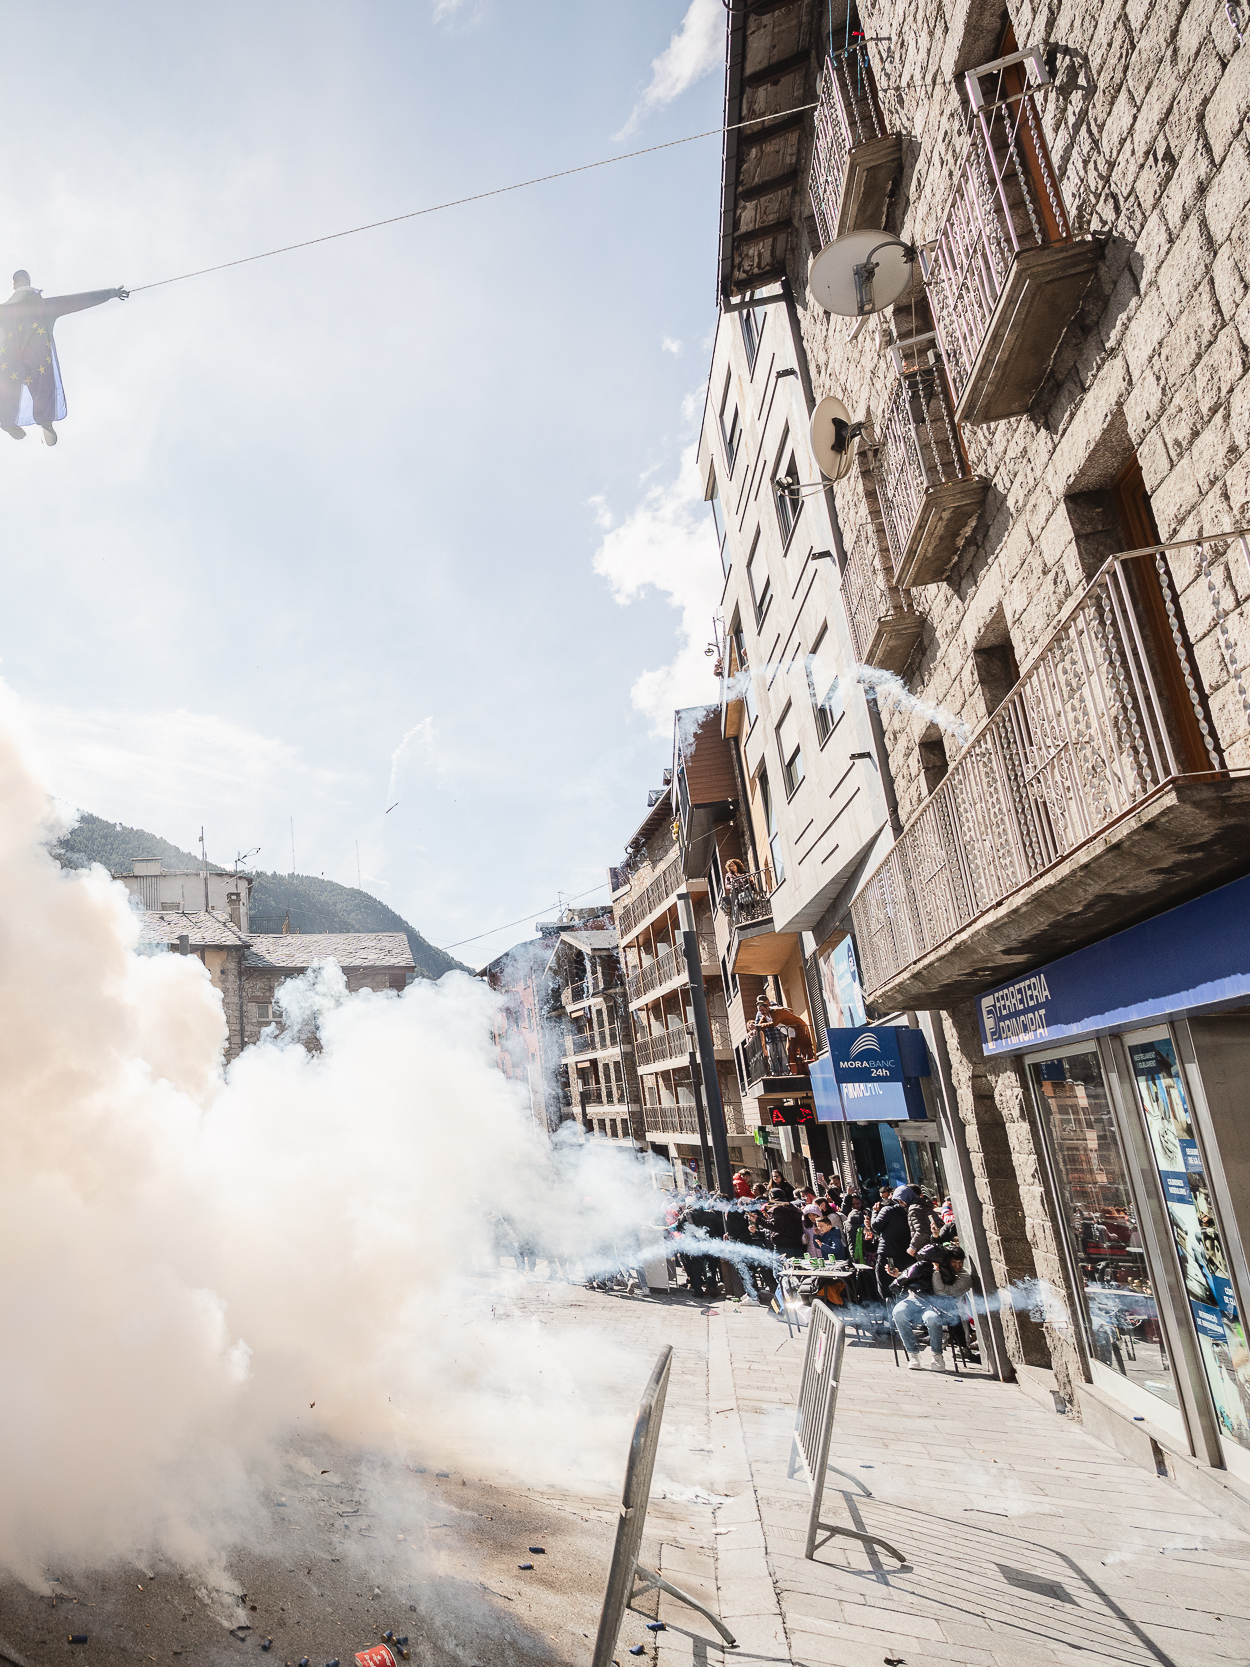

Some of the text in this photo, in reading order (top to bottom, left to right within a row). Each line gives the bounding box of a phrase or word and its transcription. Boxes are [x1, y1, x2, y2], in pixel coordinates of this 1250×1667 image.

[994, 973, 1051, 1017] FERRETERIA
[999, 1009, 1048, 1046] PRINCIPAT
[840, 1060, 895, 1068] MORABANC
[871, 1069, 890, 1077] 24h
